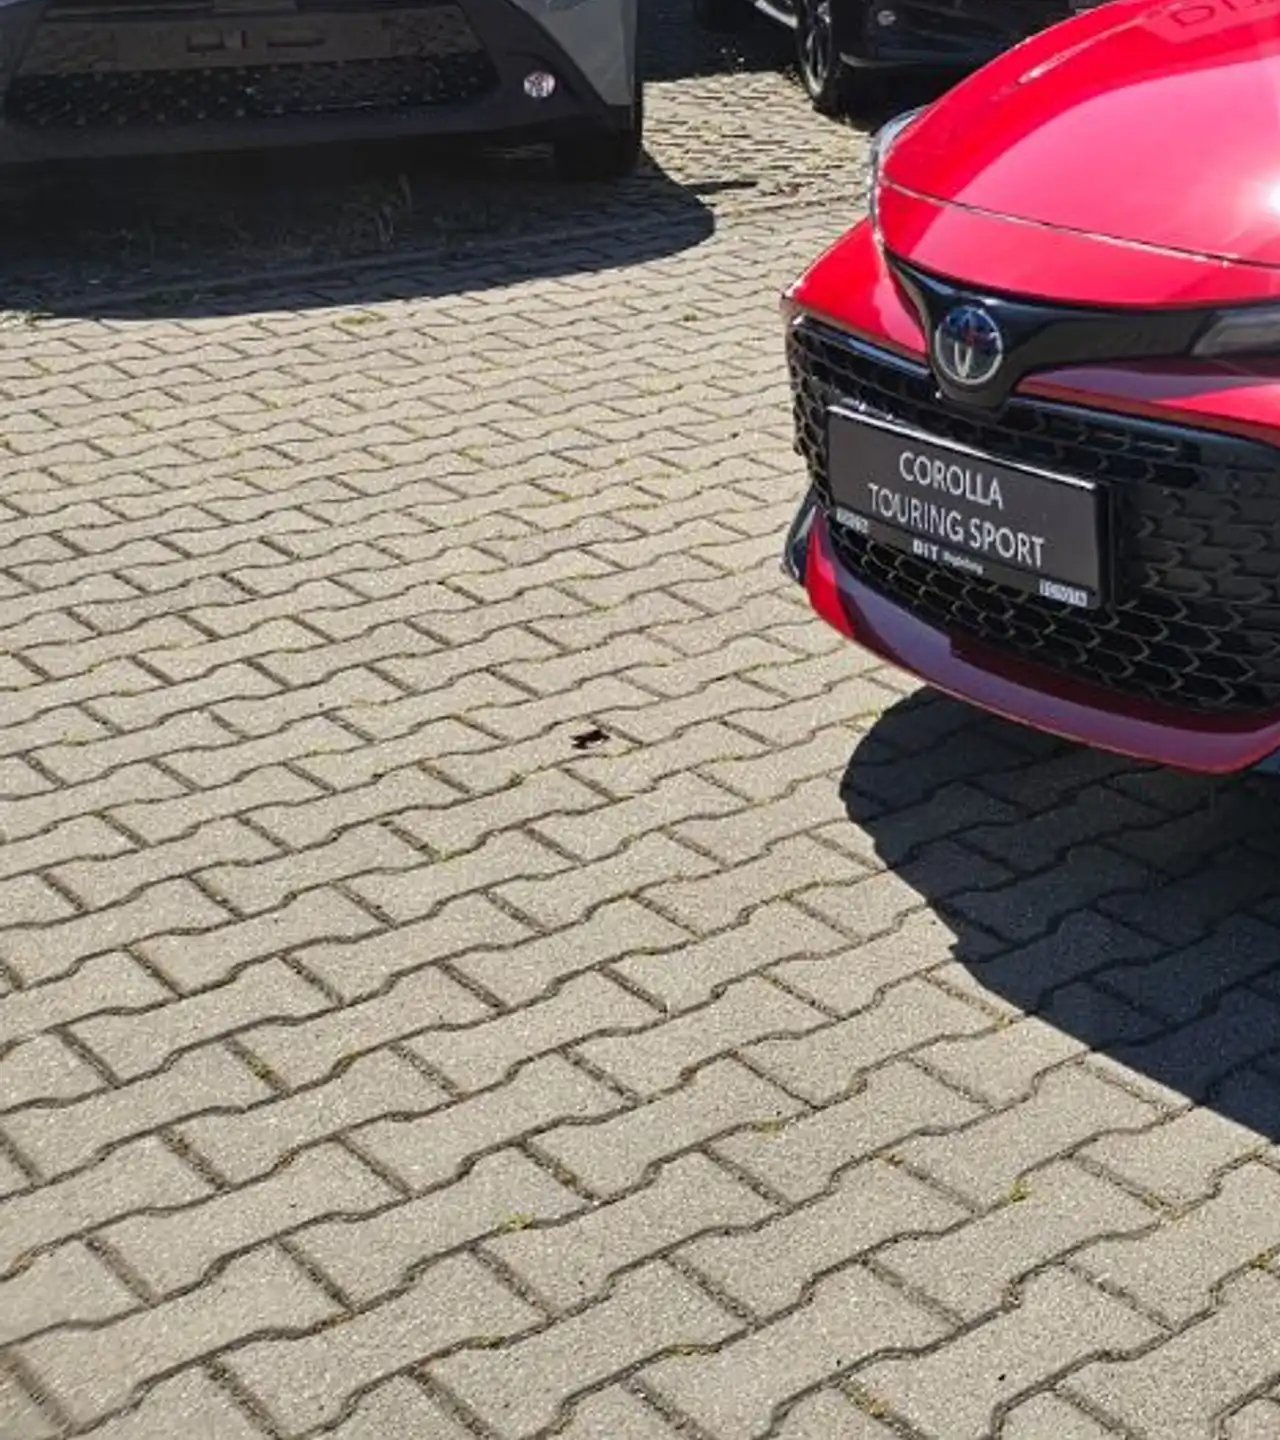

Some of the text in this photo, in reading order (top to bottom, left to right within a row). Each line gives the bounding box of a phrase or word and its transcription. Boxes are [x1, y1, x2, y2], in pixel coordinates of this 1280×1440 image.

[899, 450, 1004, 510] COROLLA
[868, 482, 964, 543] TOURING
[969, 517, 1045, 569] SPORT
